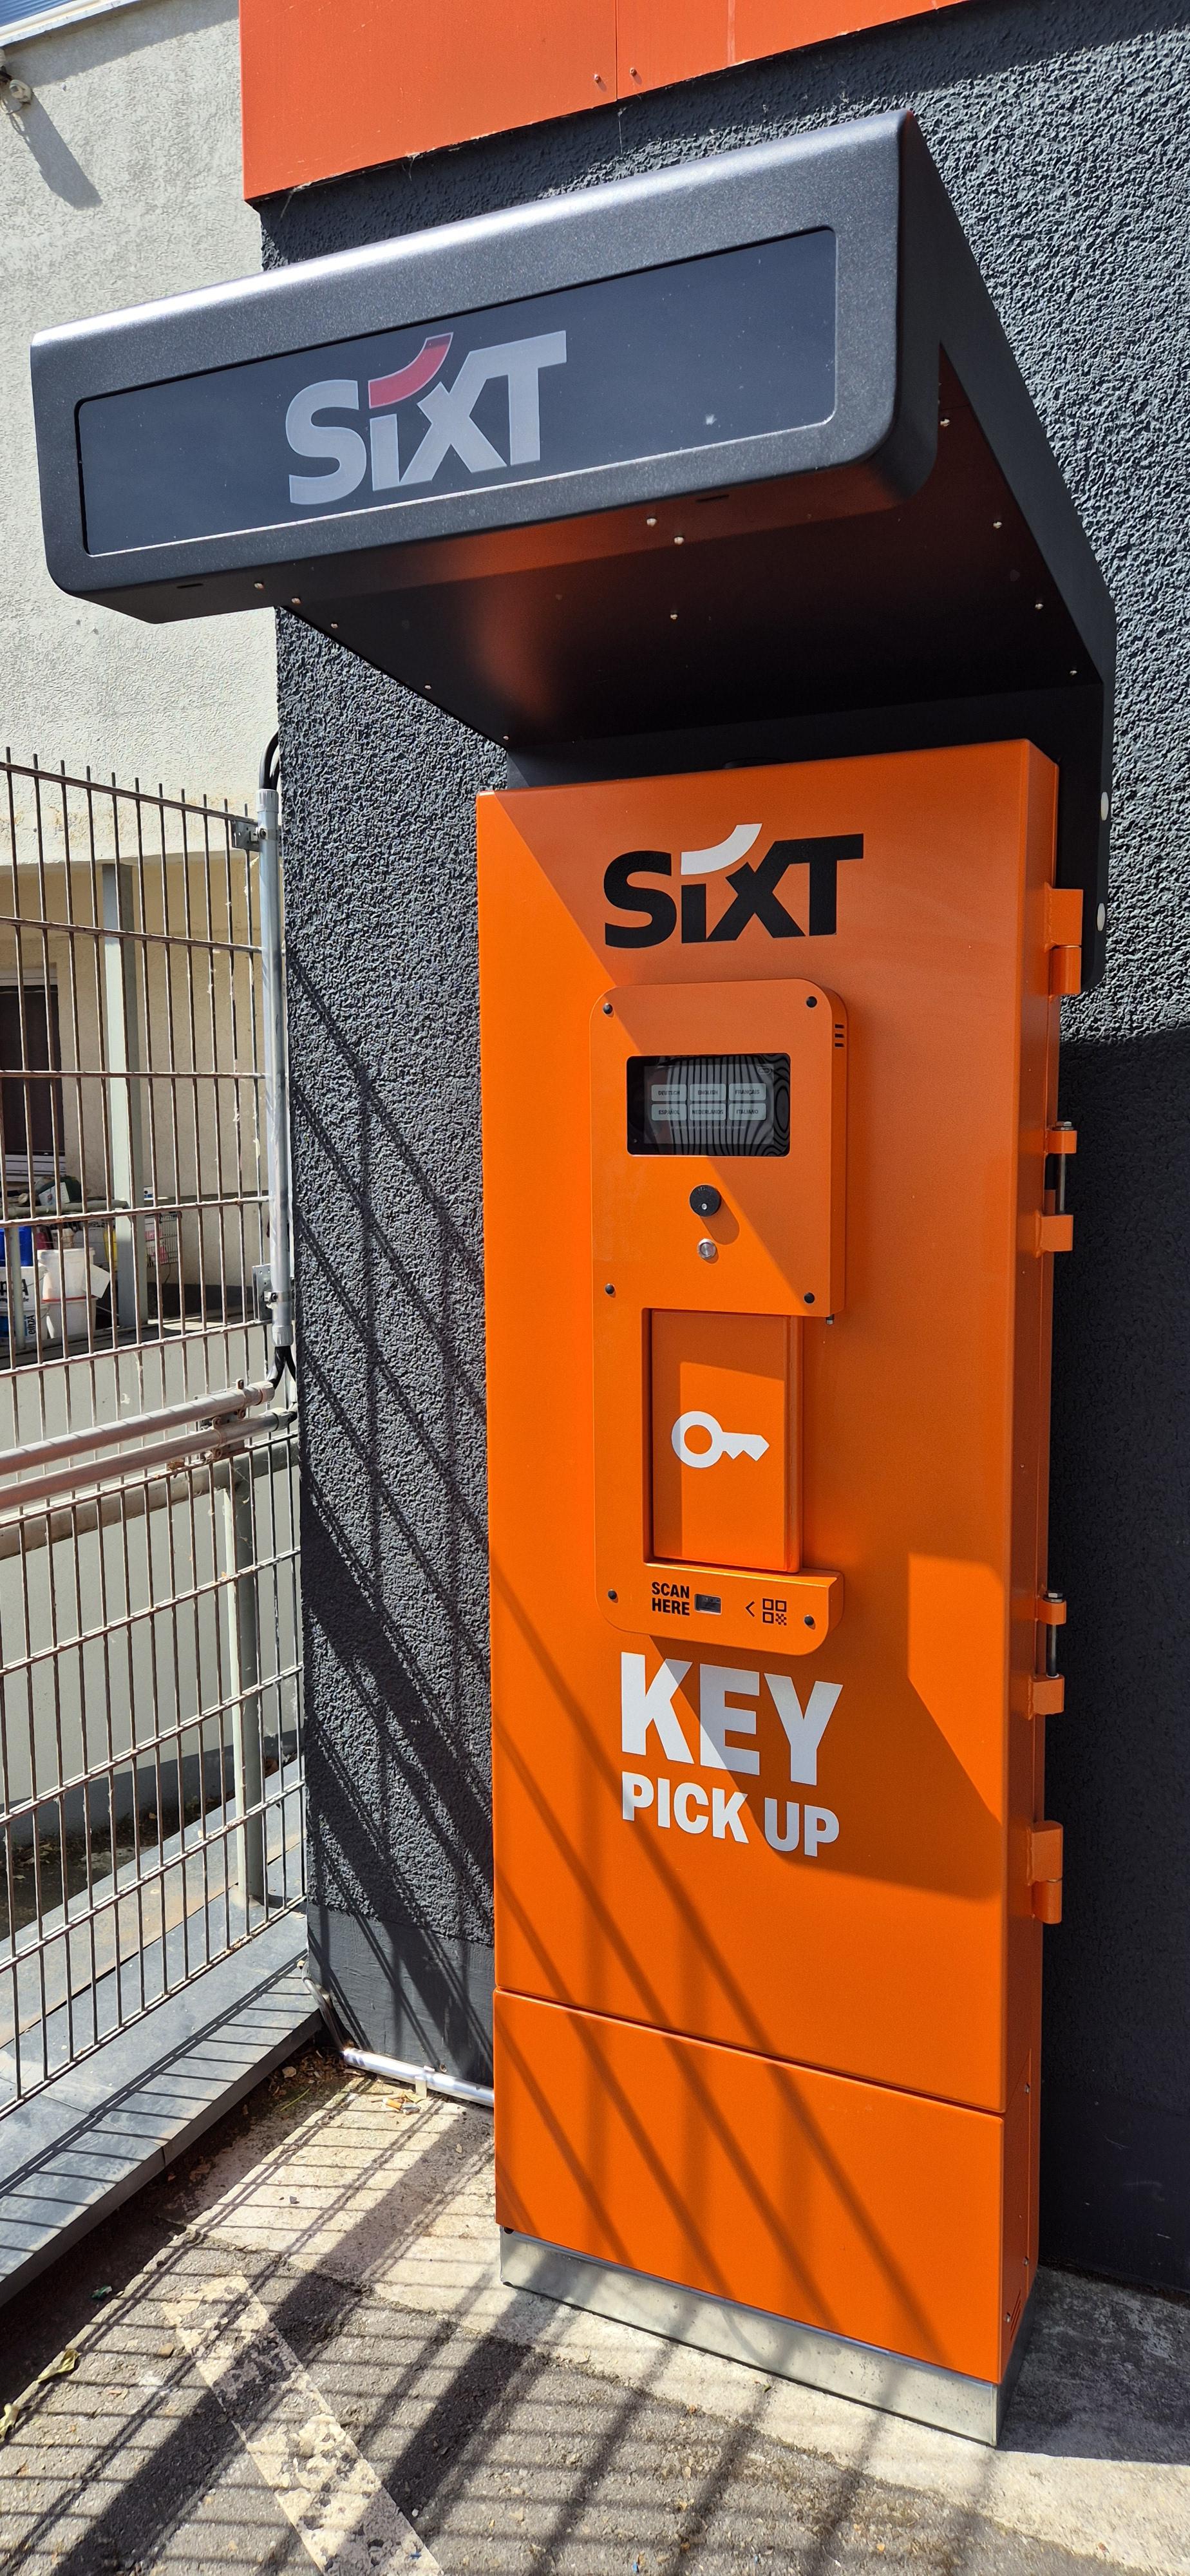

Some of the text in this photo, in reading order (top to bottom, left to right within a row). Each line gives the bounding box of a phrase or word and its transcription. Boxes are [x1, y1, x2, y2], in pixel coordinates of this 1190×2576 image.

[652, 1581, 690, 1599] SCAN
[652, 1598, 690, 1616] HERE
[621, 1651, 844, 1786] KEY
[621, 1771, 840, 1857] PICK UP
